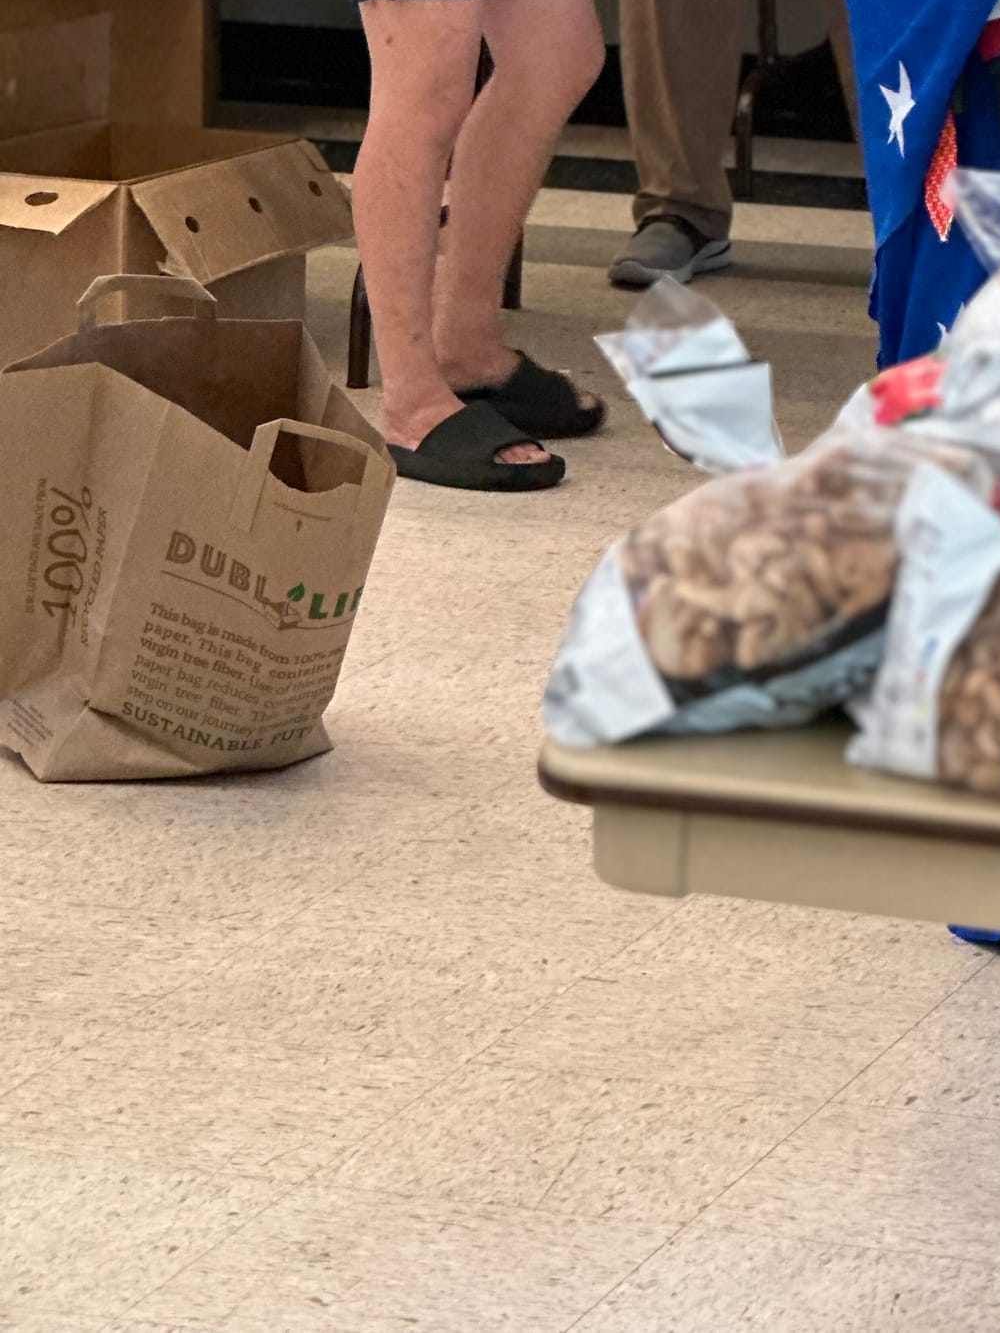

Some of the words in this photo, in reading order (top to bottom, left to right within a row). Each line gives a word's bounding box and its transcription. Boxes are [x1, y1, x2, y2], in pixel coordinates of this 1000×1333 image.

[42, 485, 93, 626] 100%
[80, 560, 102, 647] RECYCLED
[95, 506, 108, 560] PAPER
[144, 621, 192, 645] paper.
[199, 638, 232, 659] This
[236, 649, 262, 674] bag
[150, 603, 179, 623] This
[181, 610, 205, 634] bag
[207, 621, 220, 634] is
[221, 629, 258, 652] made
[259, 645, 290, 664] from
[294, 650, 327, 664] 100%
[132, 670, 167, 693] virgin
[175, 686, 202, 701] tree
[135, 654, 172, 677] paper
[177, 668, 202, 689] bag
[206, 678, 260, 705] reduces
[140, 637, 179, 658] virgin
[182, 651, 210, 667] tree
[211, 660, 246, 682] fiber.
[250, 675, 273, 694] Use
[121, 701, 263, 752] SUSTAINABLE
[270, 726, 314, 747] FUT
[126, 686, 154, 705] step
[156, 698, 174, 711] on
[176, 705, 201, 721] our
[201, 713, 257, 736] journey
